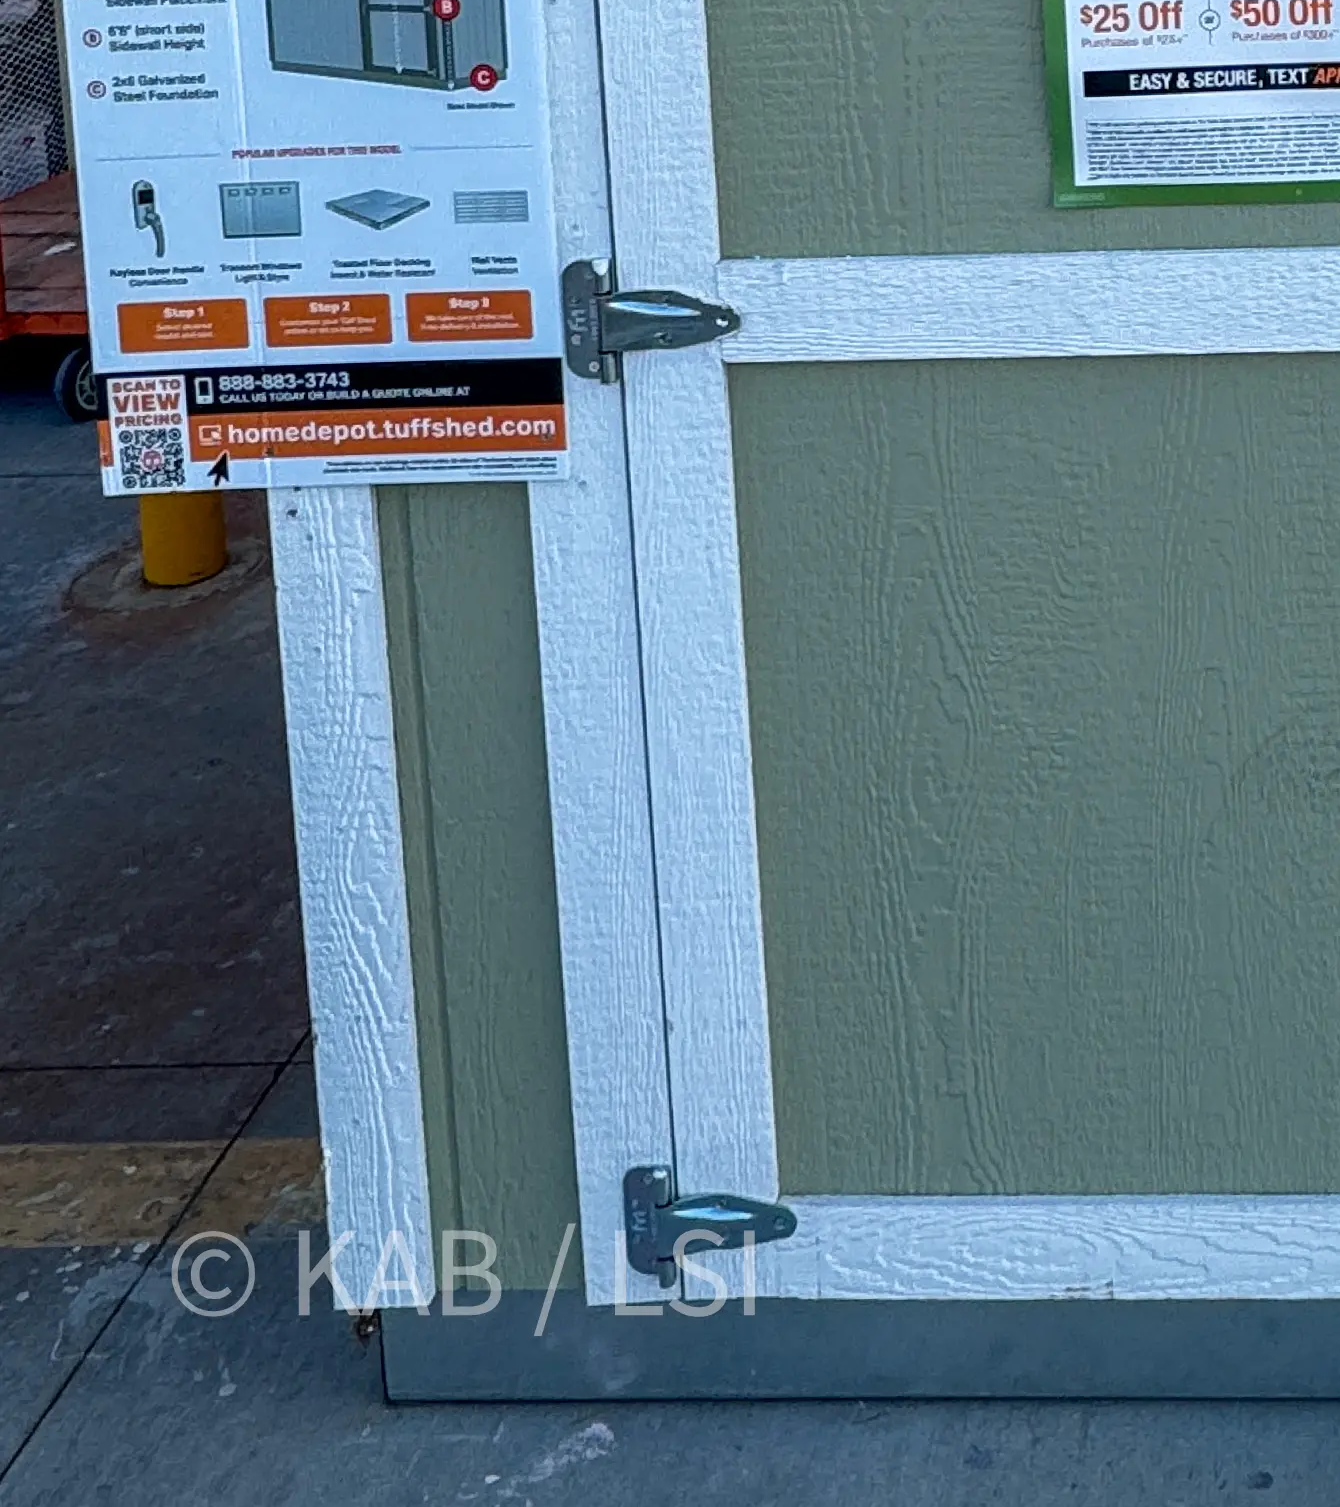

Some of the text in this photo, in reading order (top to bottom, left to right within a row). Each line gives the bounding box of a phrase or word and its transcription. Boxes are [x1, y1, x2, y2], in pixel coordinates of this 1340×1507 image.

[441, 0, 453, 14] B
[1080, 0, 1183, 33] $25 Off
[164, 39, 205, 50] Height
[138, 74, 206, 86] Galvanized
[478, 71, 490, 84] C
[1129, 72, 1173, 90] EASY
[1177, 72, 1190, 89] &
[1194, 69, 1264, 89] SECURE,
[1268, 67, 1309, 85] TEXT
[149, 89, 219, 101] Foundation
[309, 301, 350, 314] Step 2
[449, 297, 480, 309] Step
[163, 306, 204, 319] Step 1
[112, 379, 180, 393] SCAN TO
[219, 371, 350, 392] 888-883-3743
[219, 386, 470, 404] CALL US TODAY OR BUILD A QUOTE ONLINE AT
[113, 393, 181, 413] VIEW
[115, 414, 182, 428] PRICING
[228, 415, 556, 445] homedepot.tuffshed.com
